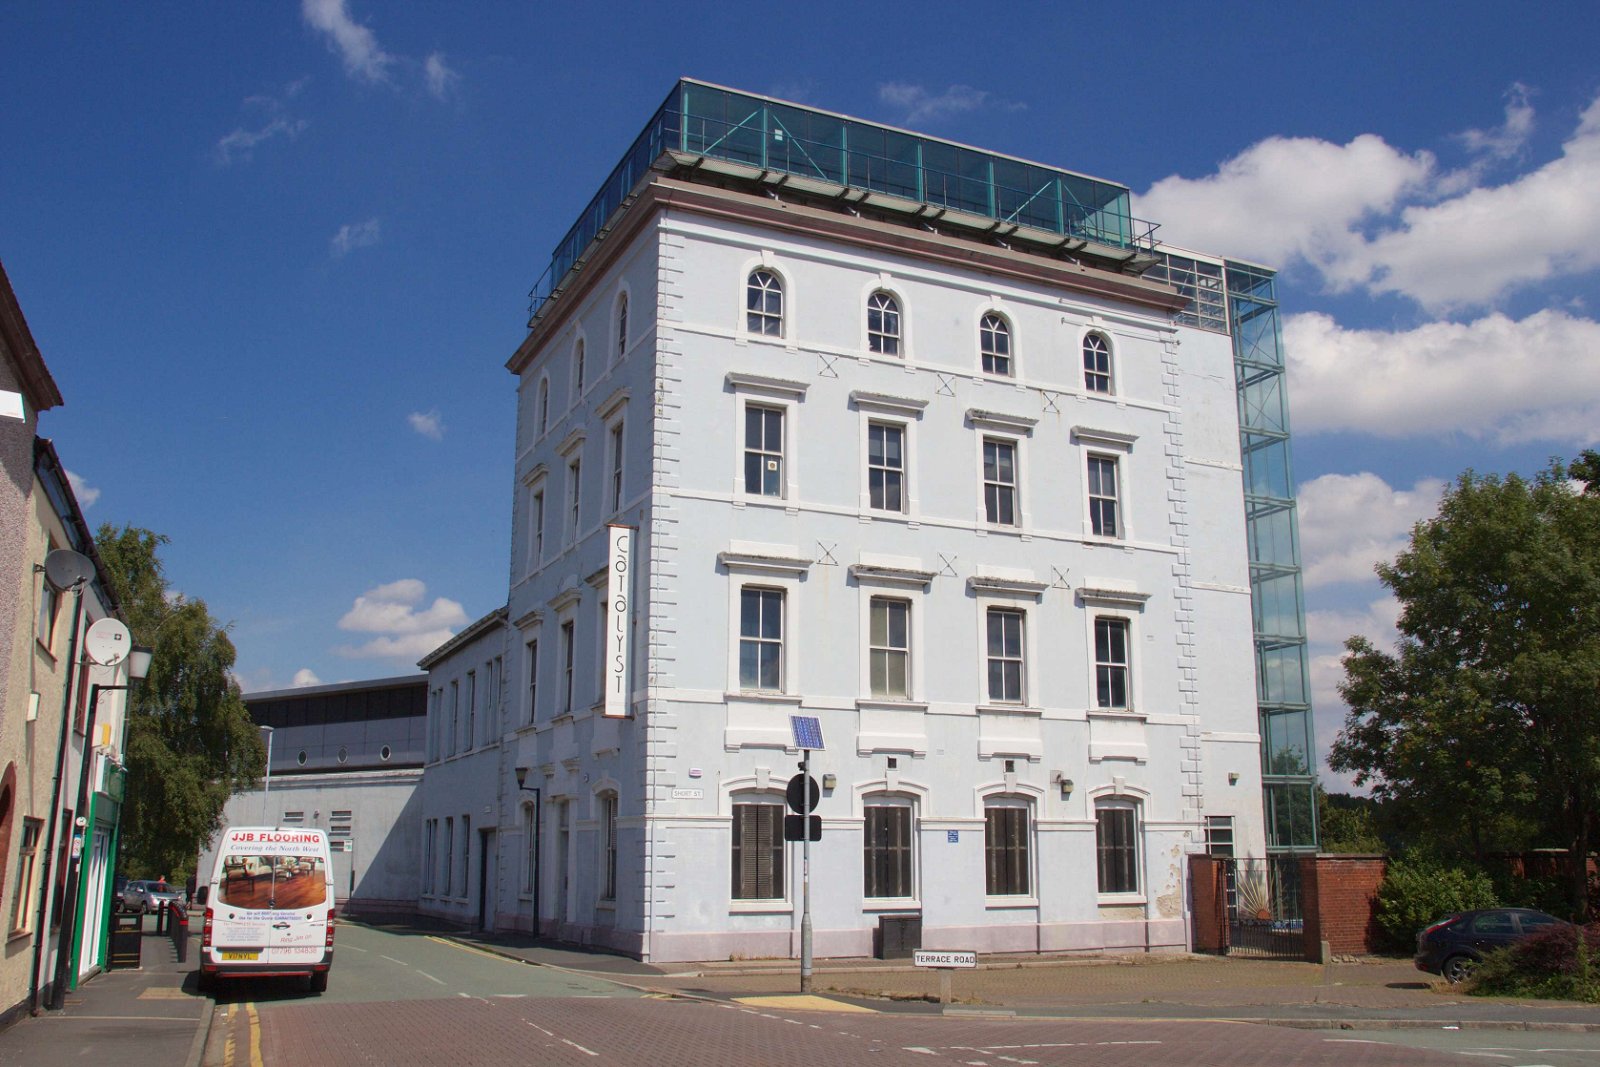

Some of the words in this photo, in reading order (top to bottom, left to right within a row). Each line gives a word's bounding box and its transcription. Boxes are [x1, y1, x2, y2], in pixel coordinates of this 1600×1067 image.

[232, 833, 254, 841] JJB
[259, 833, 320, 843] FLOORING
[231, 845, 262, 853] Covering
[916, 955, 952, 963] TERRACE
